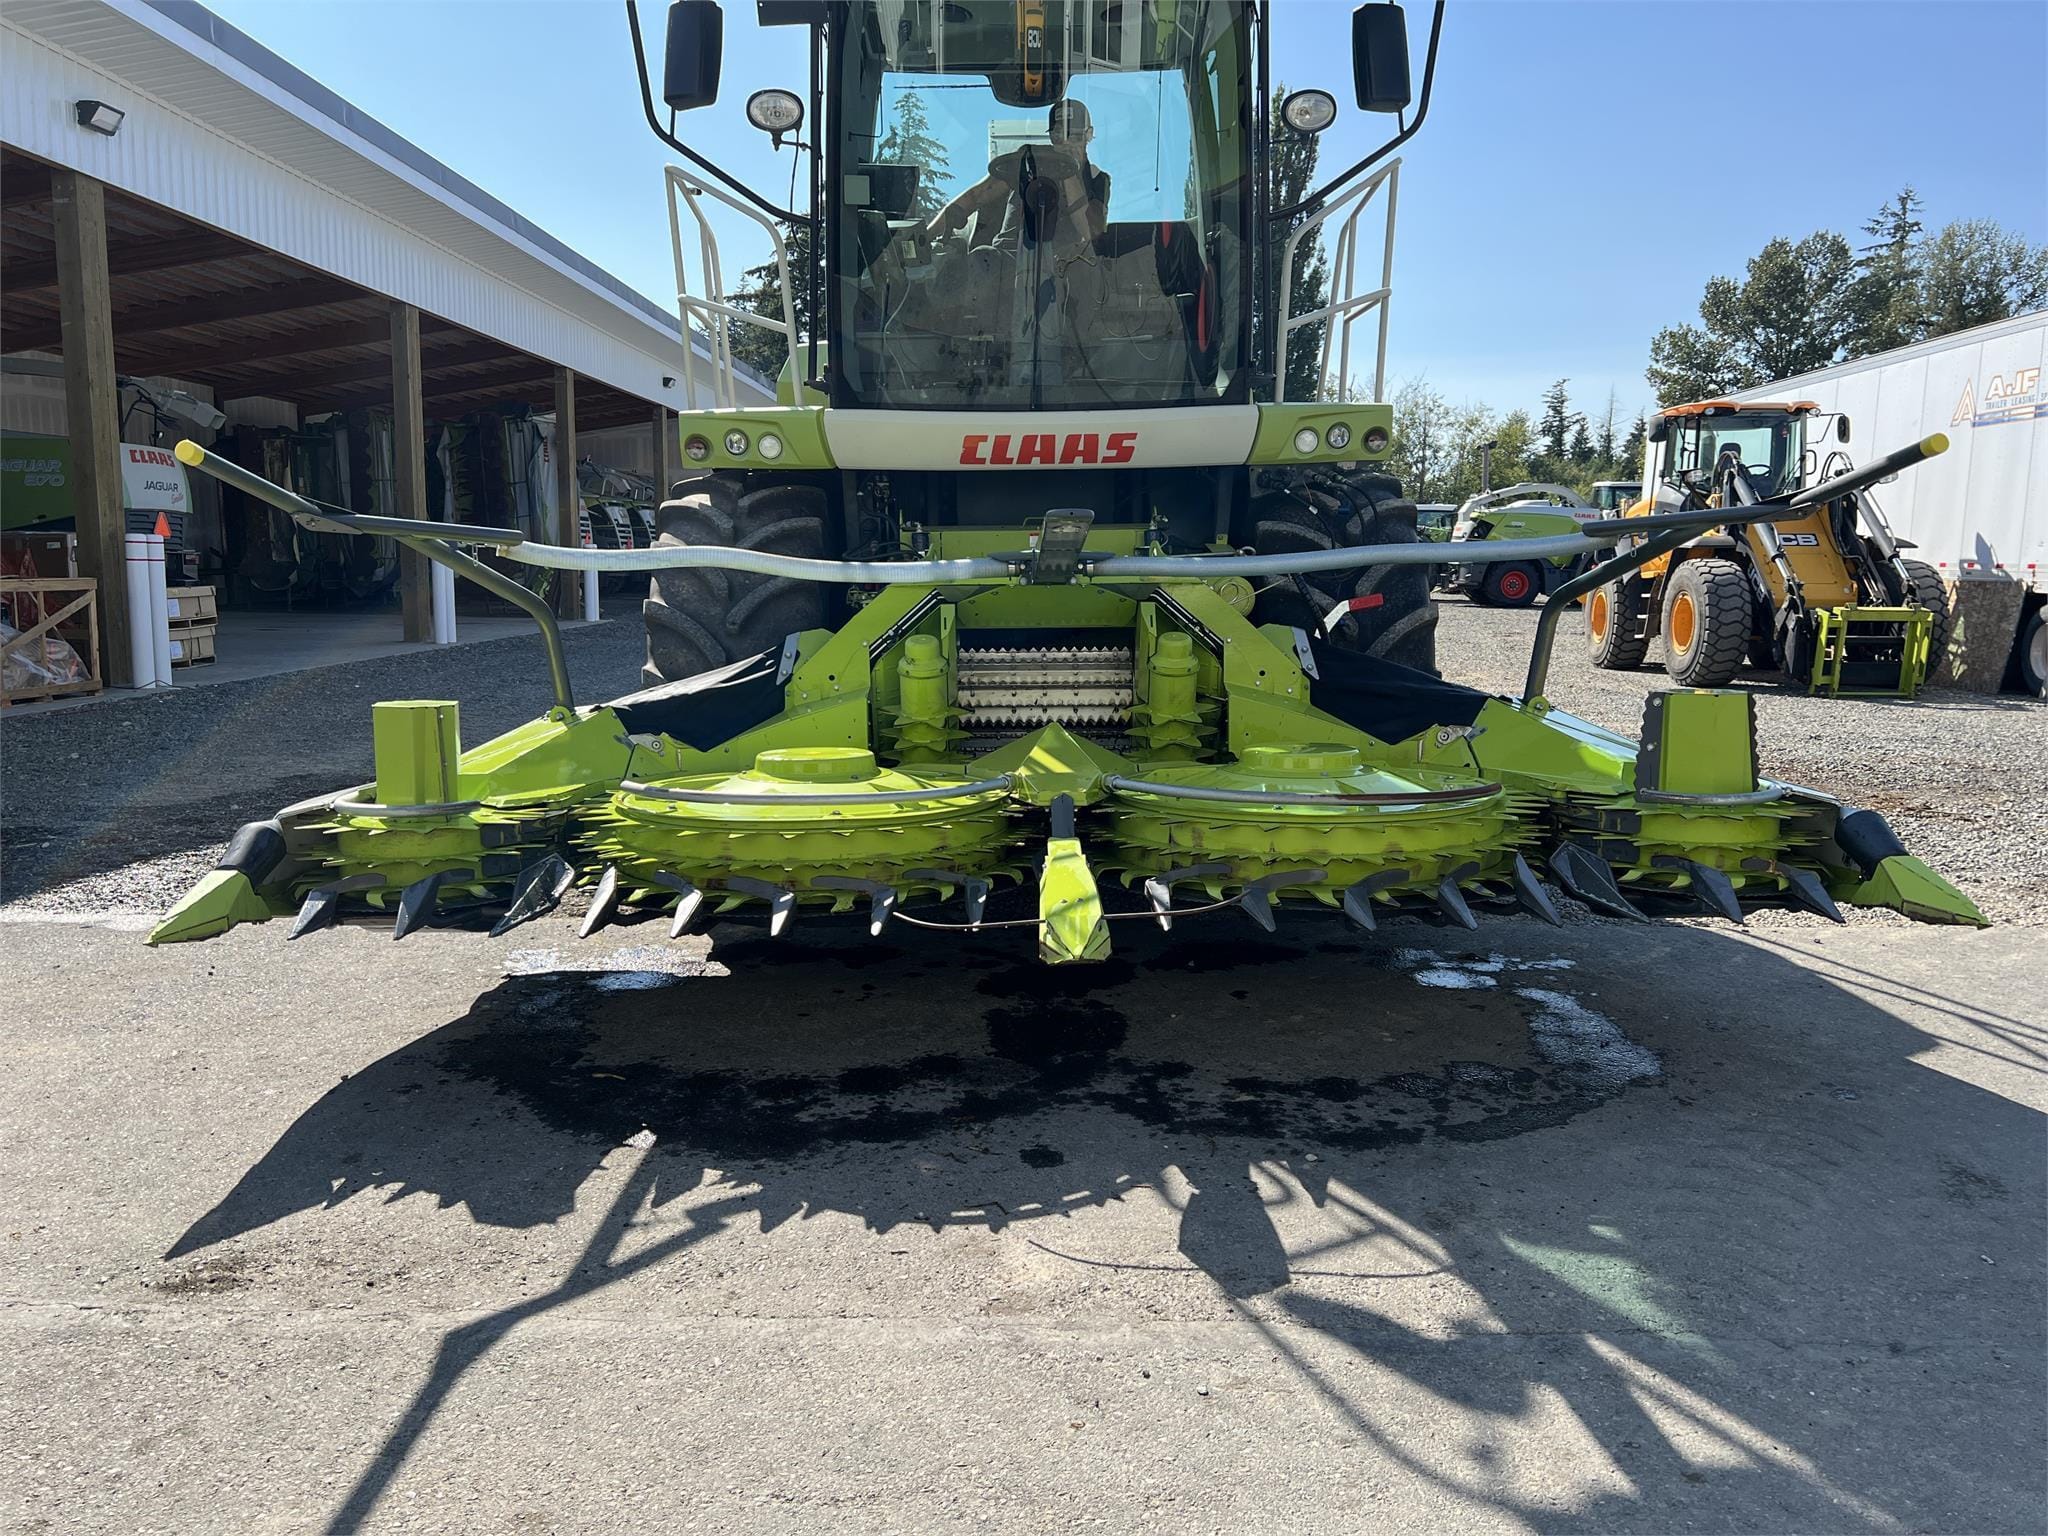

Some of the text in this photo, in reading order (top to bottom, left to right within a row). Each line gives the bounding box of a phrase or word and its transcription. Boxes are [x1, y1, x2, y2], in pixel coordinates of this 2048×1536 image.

[960, 433, 1138, 464] CLAAS
[0, 458, 62, 472] AGUAR
[128, 449, 176, 468] CLAAS
[144, 480, 179, 492] JAGUAR
[1780, 534, 1818, 545] CB
